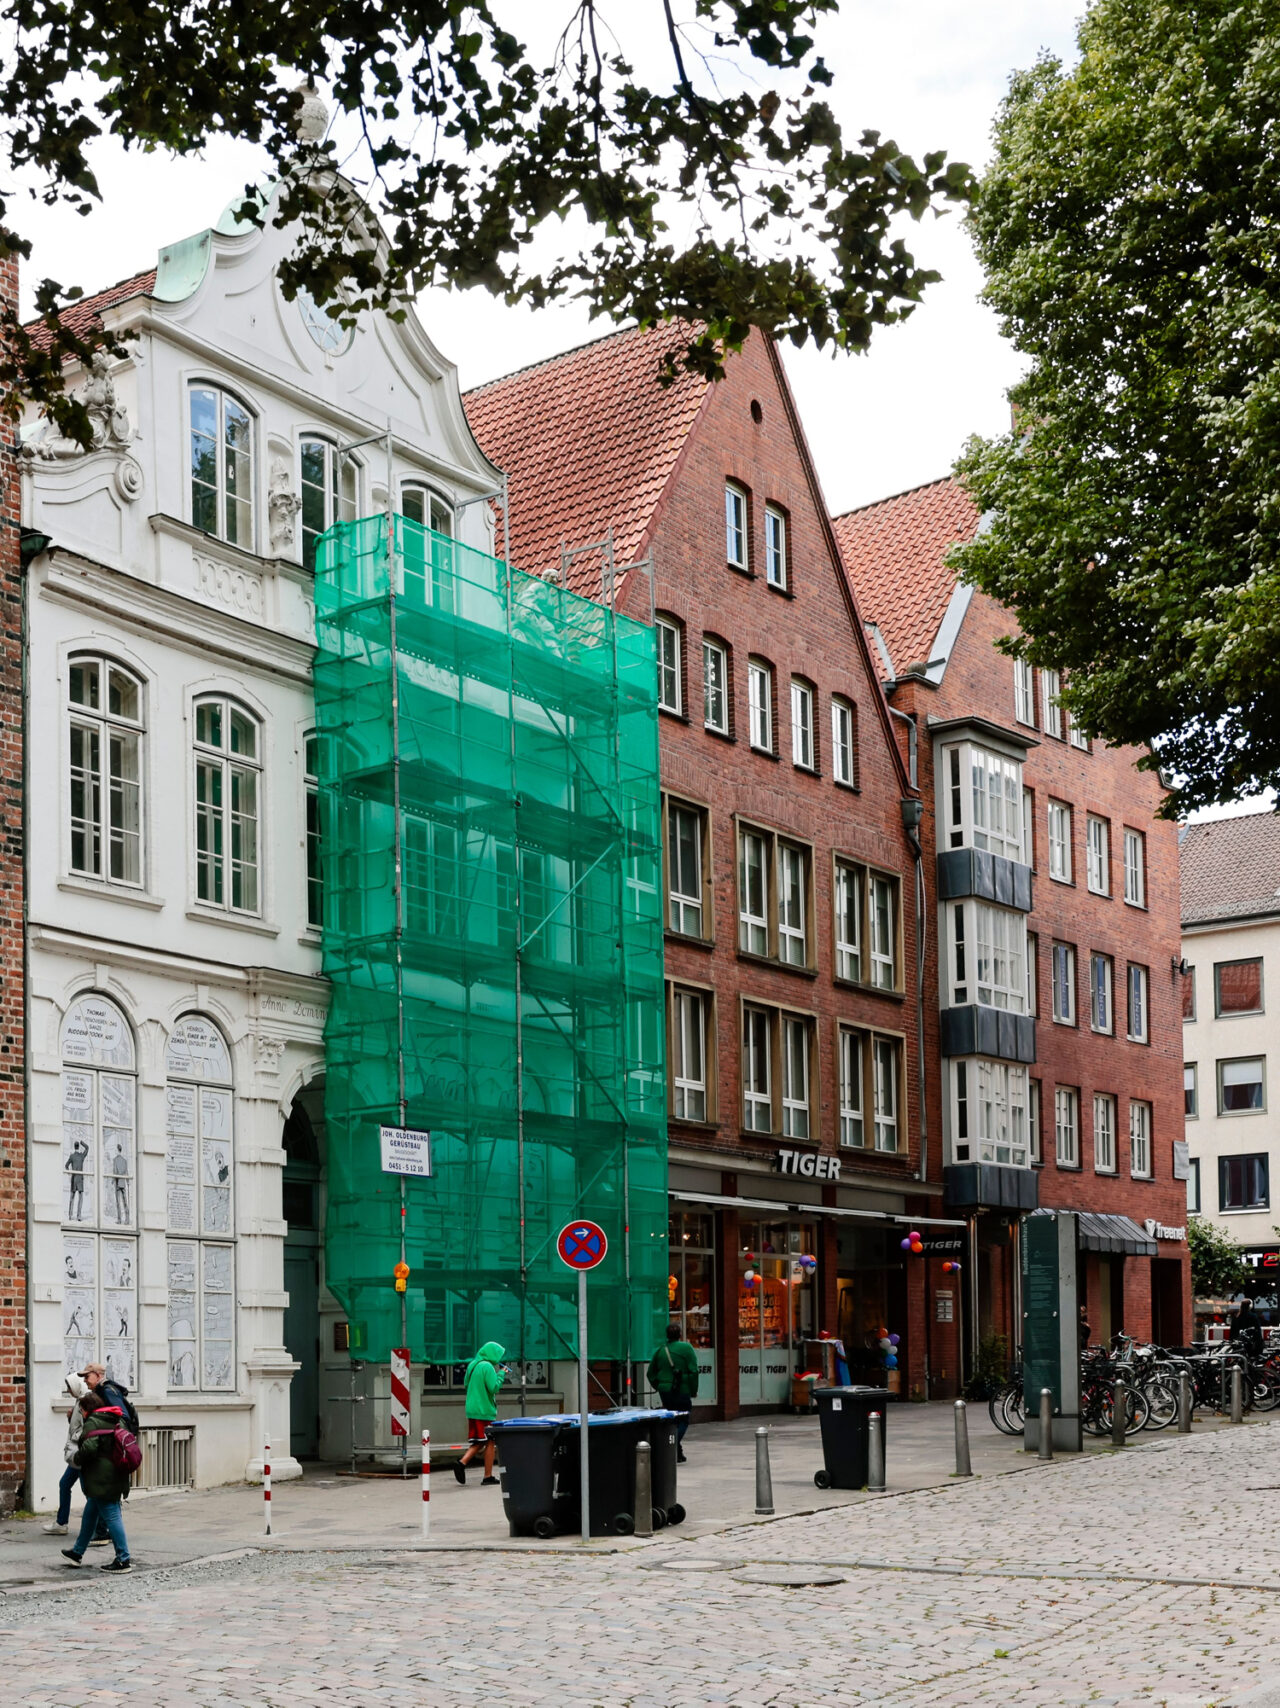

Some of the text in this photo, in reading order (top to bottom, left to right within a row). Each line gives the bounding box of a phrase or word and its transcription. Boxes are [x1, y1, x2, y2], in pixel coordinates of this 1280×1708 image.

[293, 1000, 327, 1020] Domin
[396, 1132, 427, 1142] OLDENBURG
[390, 1140, 421, 1150] GERÜSTBAU
[389, 1162, 401, 1170] 0451
[778, 1149, 841, 1180] TIGER
[1156, 1222, 1186, 1240] freenet
[922, 1240, 962, 1250] TIGER
